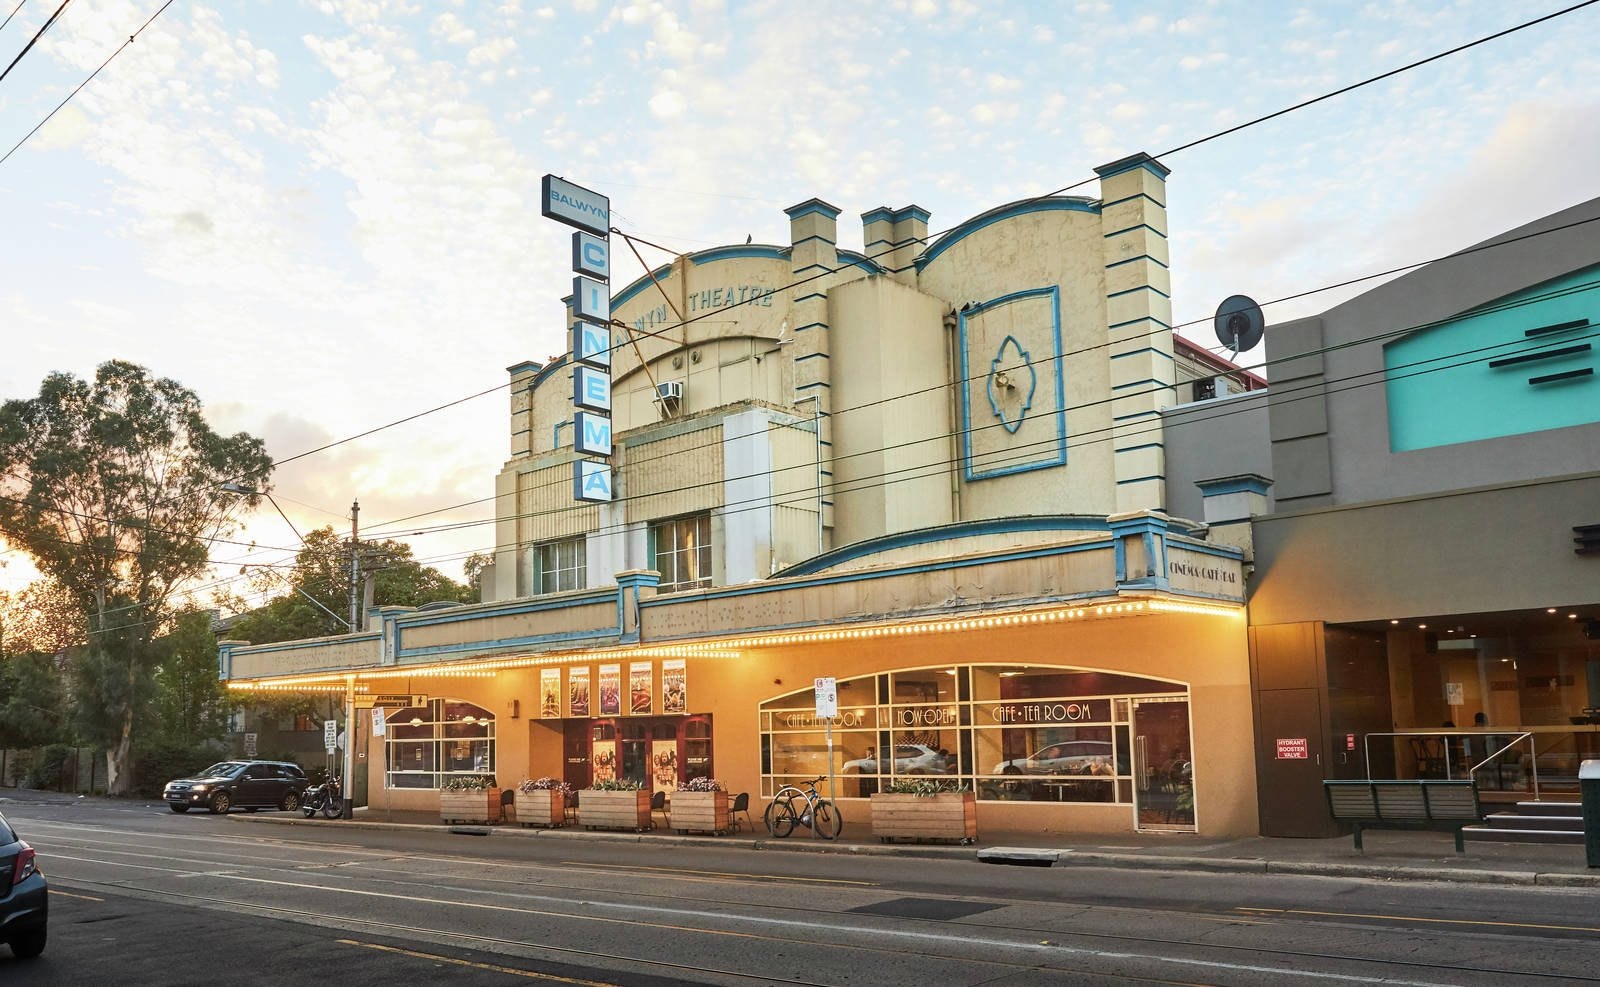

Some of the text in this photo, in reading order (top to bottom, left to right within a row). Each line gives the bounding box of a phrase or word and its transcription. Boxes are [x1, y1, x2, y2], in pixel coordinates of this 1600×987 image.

[551, 190, 607, 219] BALWYN
[689, 284, 776, 311] THEATRE
[583, 242, 609, 493] CINEMA
[1170, 562, 1199, 577] CINEMA
[787, 714, 805, 728] CAFE
[831, 711, 862, 726] OOM
[897, 709, 954, 725] NOW OPEN
[992, 703, 1091, 722] CAFE TEA ROOM
